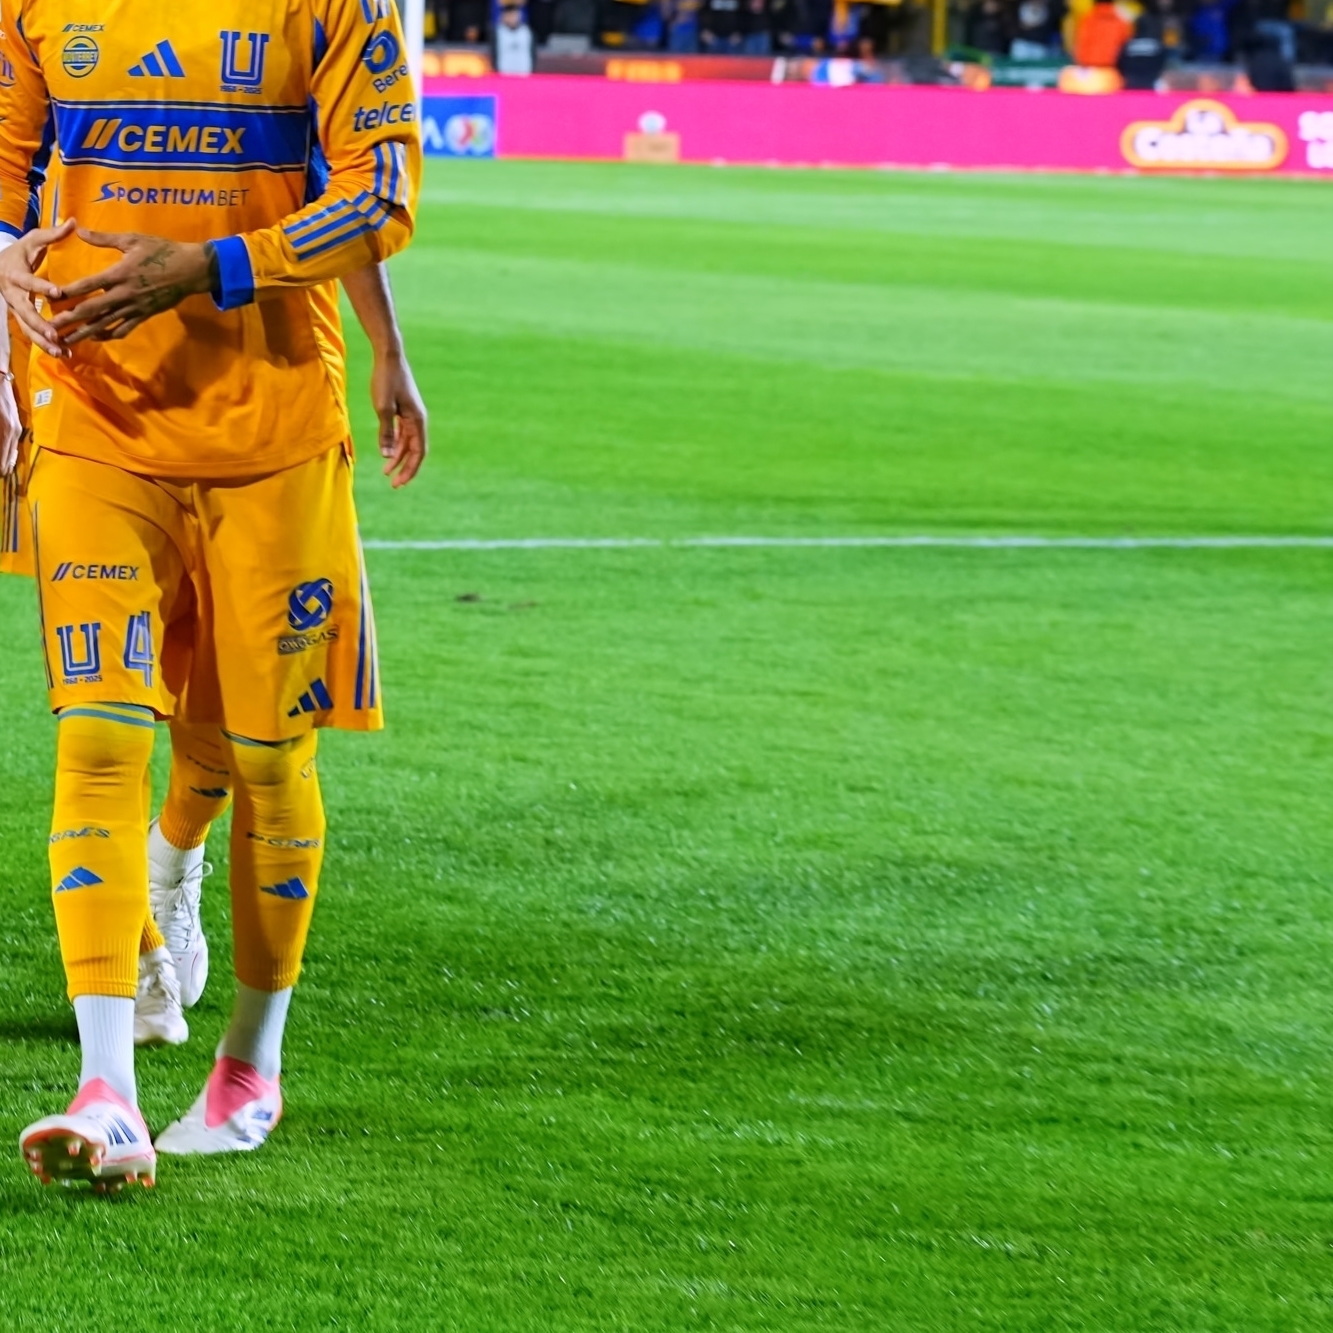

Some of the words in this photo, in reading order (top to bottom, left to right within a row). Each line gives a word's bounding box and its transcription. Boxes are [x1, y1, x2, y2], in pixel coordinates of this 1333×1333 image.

[72, 24, 105, 32] CEMEX
[219, 31, 270, 86] U
[373, 59, 408, 93] Bere
[118, 125, 246, 154] CEMEX
[91, 181, 249, 207] SPORTIUMBET
[72, 564, 140, 581] CEMEX
[56, 622, 101, 676] U
[124, 610, 154, 688] 4
